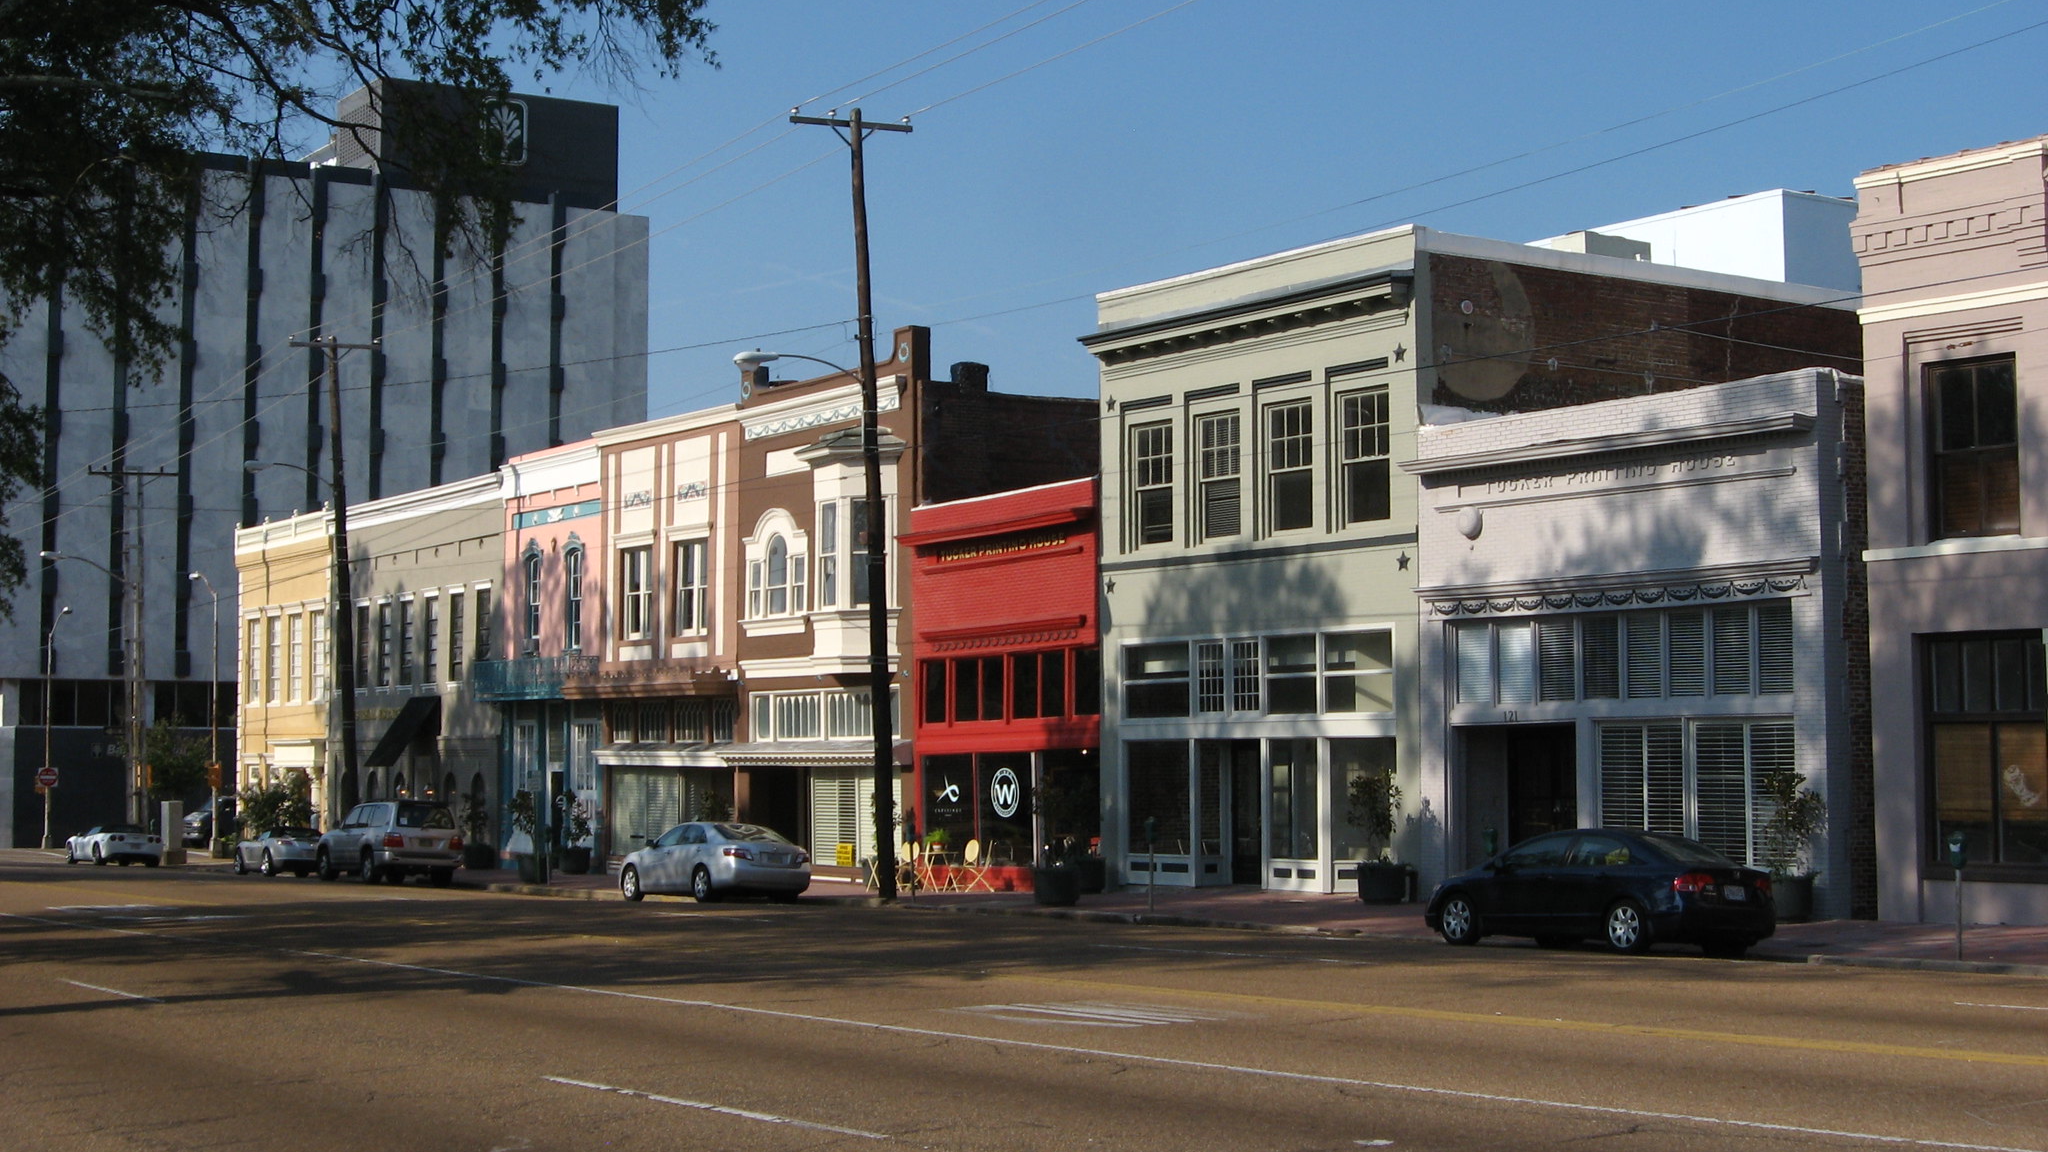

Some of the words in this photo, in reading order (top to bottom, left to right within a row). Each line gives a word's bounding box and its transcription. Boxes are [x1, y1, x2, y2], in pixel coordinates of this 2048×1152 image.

[1485, 475, 1554, 494] TUCKER
[1566, 464, 1657, 485] PRINTING
[1670, 455, 1736, 473] HOUSE
[940, 547, 977, 562] TUCKER
[979, 537, 1027, 557] PRINTING
[1029, 532, 1066, 549] HOUSE
[1503, 710, 1519, 723] 121
[994, 784, 1016, 805] W
